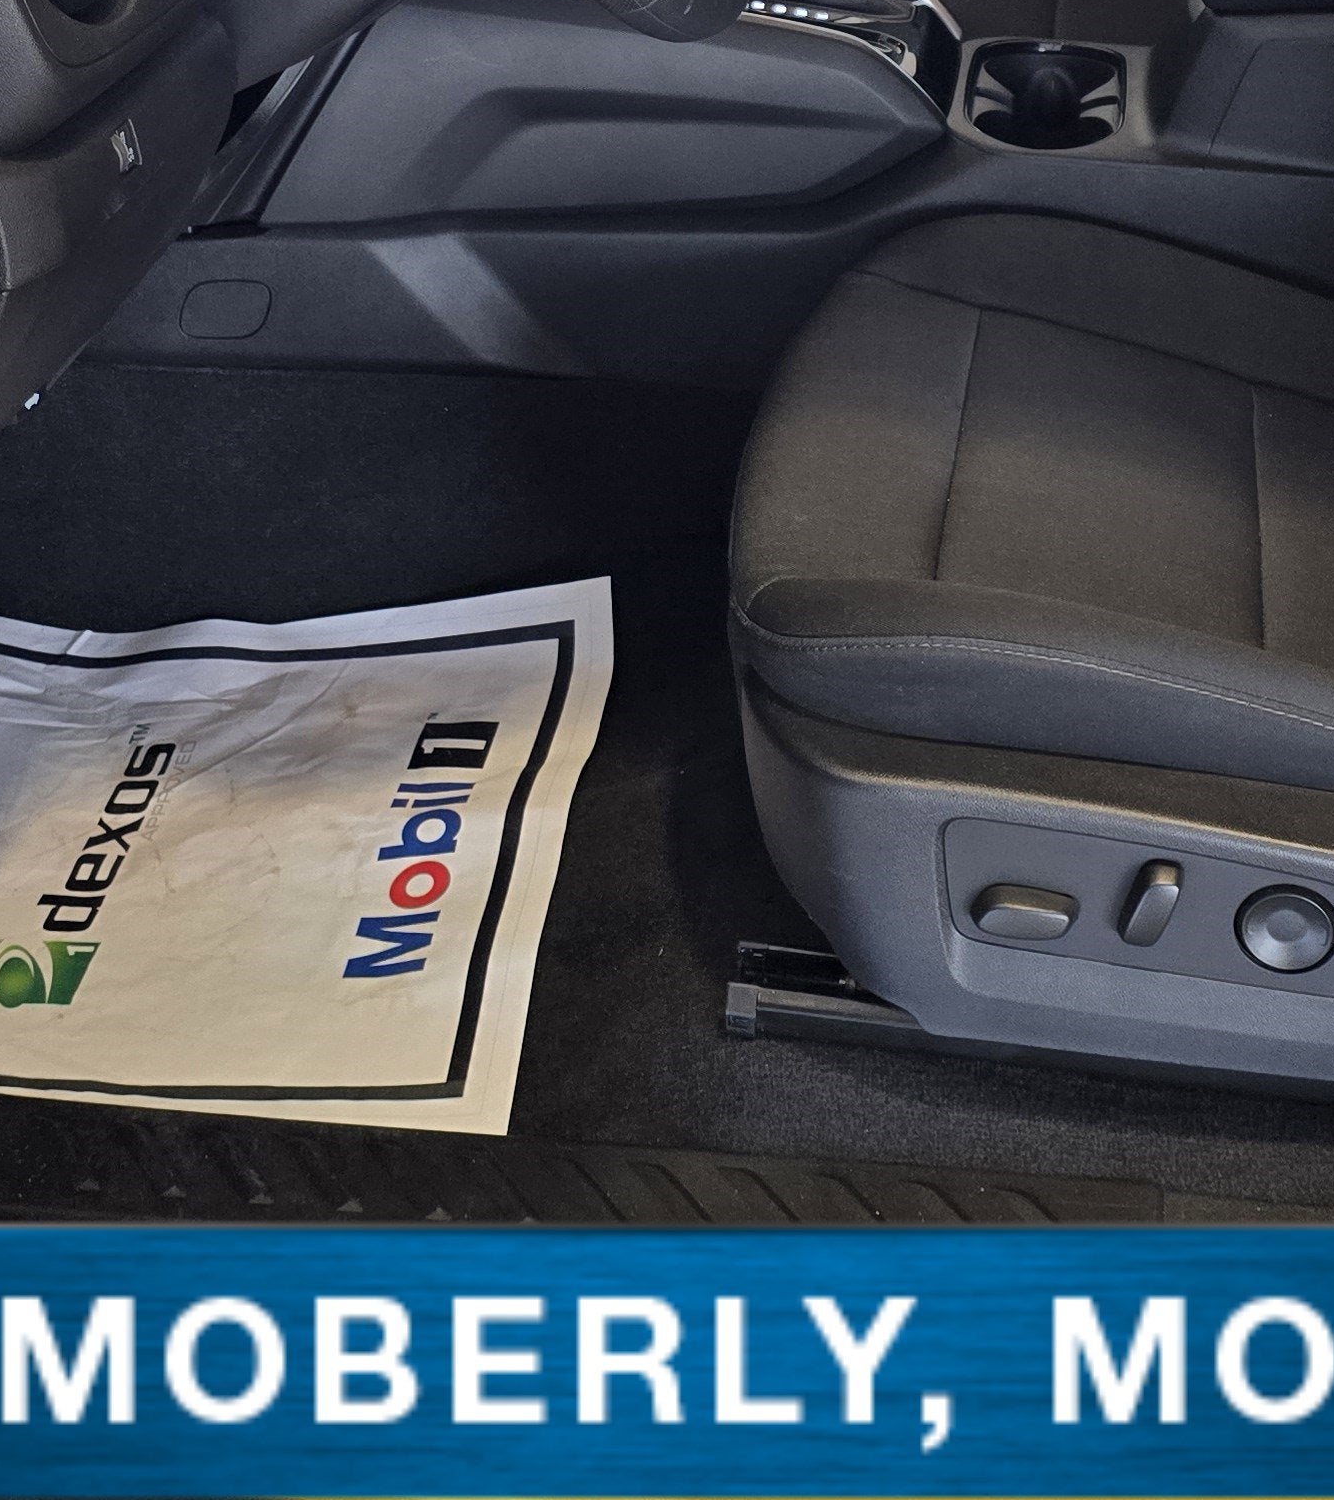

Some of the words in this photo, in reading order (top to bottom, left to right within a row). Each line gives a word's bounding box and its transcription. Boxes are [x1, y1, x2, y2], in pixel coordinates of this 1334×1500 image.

[36, 742, 177, 932] dexos
[139, 739, 197, 844] APPROVED
[342, 781, 477, 979] Mobil
